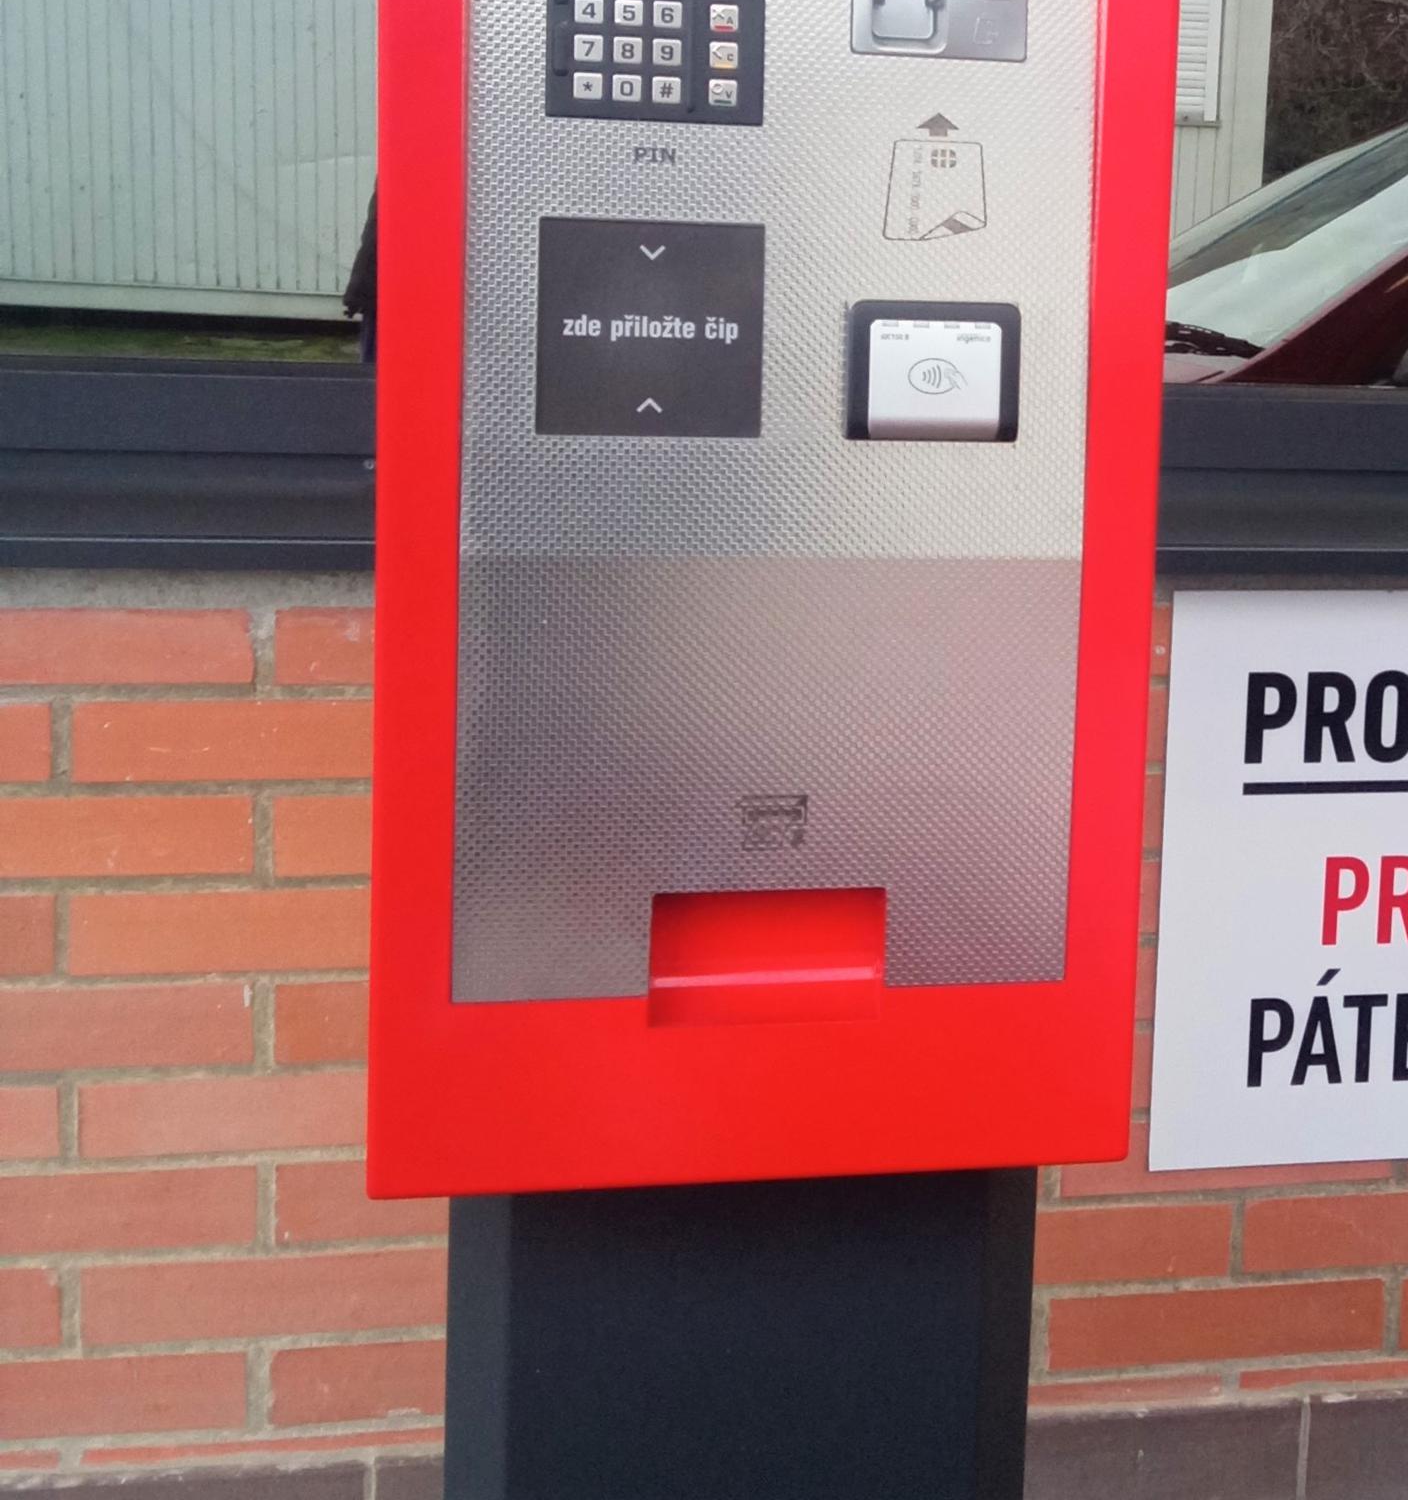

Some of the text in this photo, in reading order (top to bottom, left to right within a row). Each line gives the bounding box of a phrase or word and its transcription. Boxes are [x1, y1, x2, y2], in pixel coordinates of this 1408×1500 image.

[582, 3, 674, 23] 4 5 6
[582, 41, 674, 61] 7 8 9
[620, 80, 633, 96] 0
[633, 147, 677, 164] PIN
[563, 316, 739, 344] zde přiložte čip
